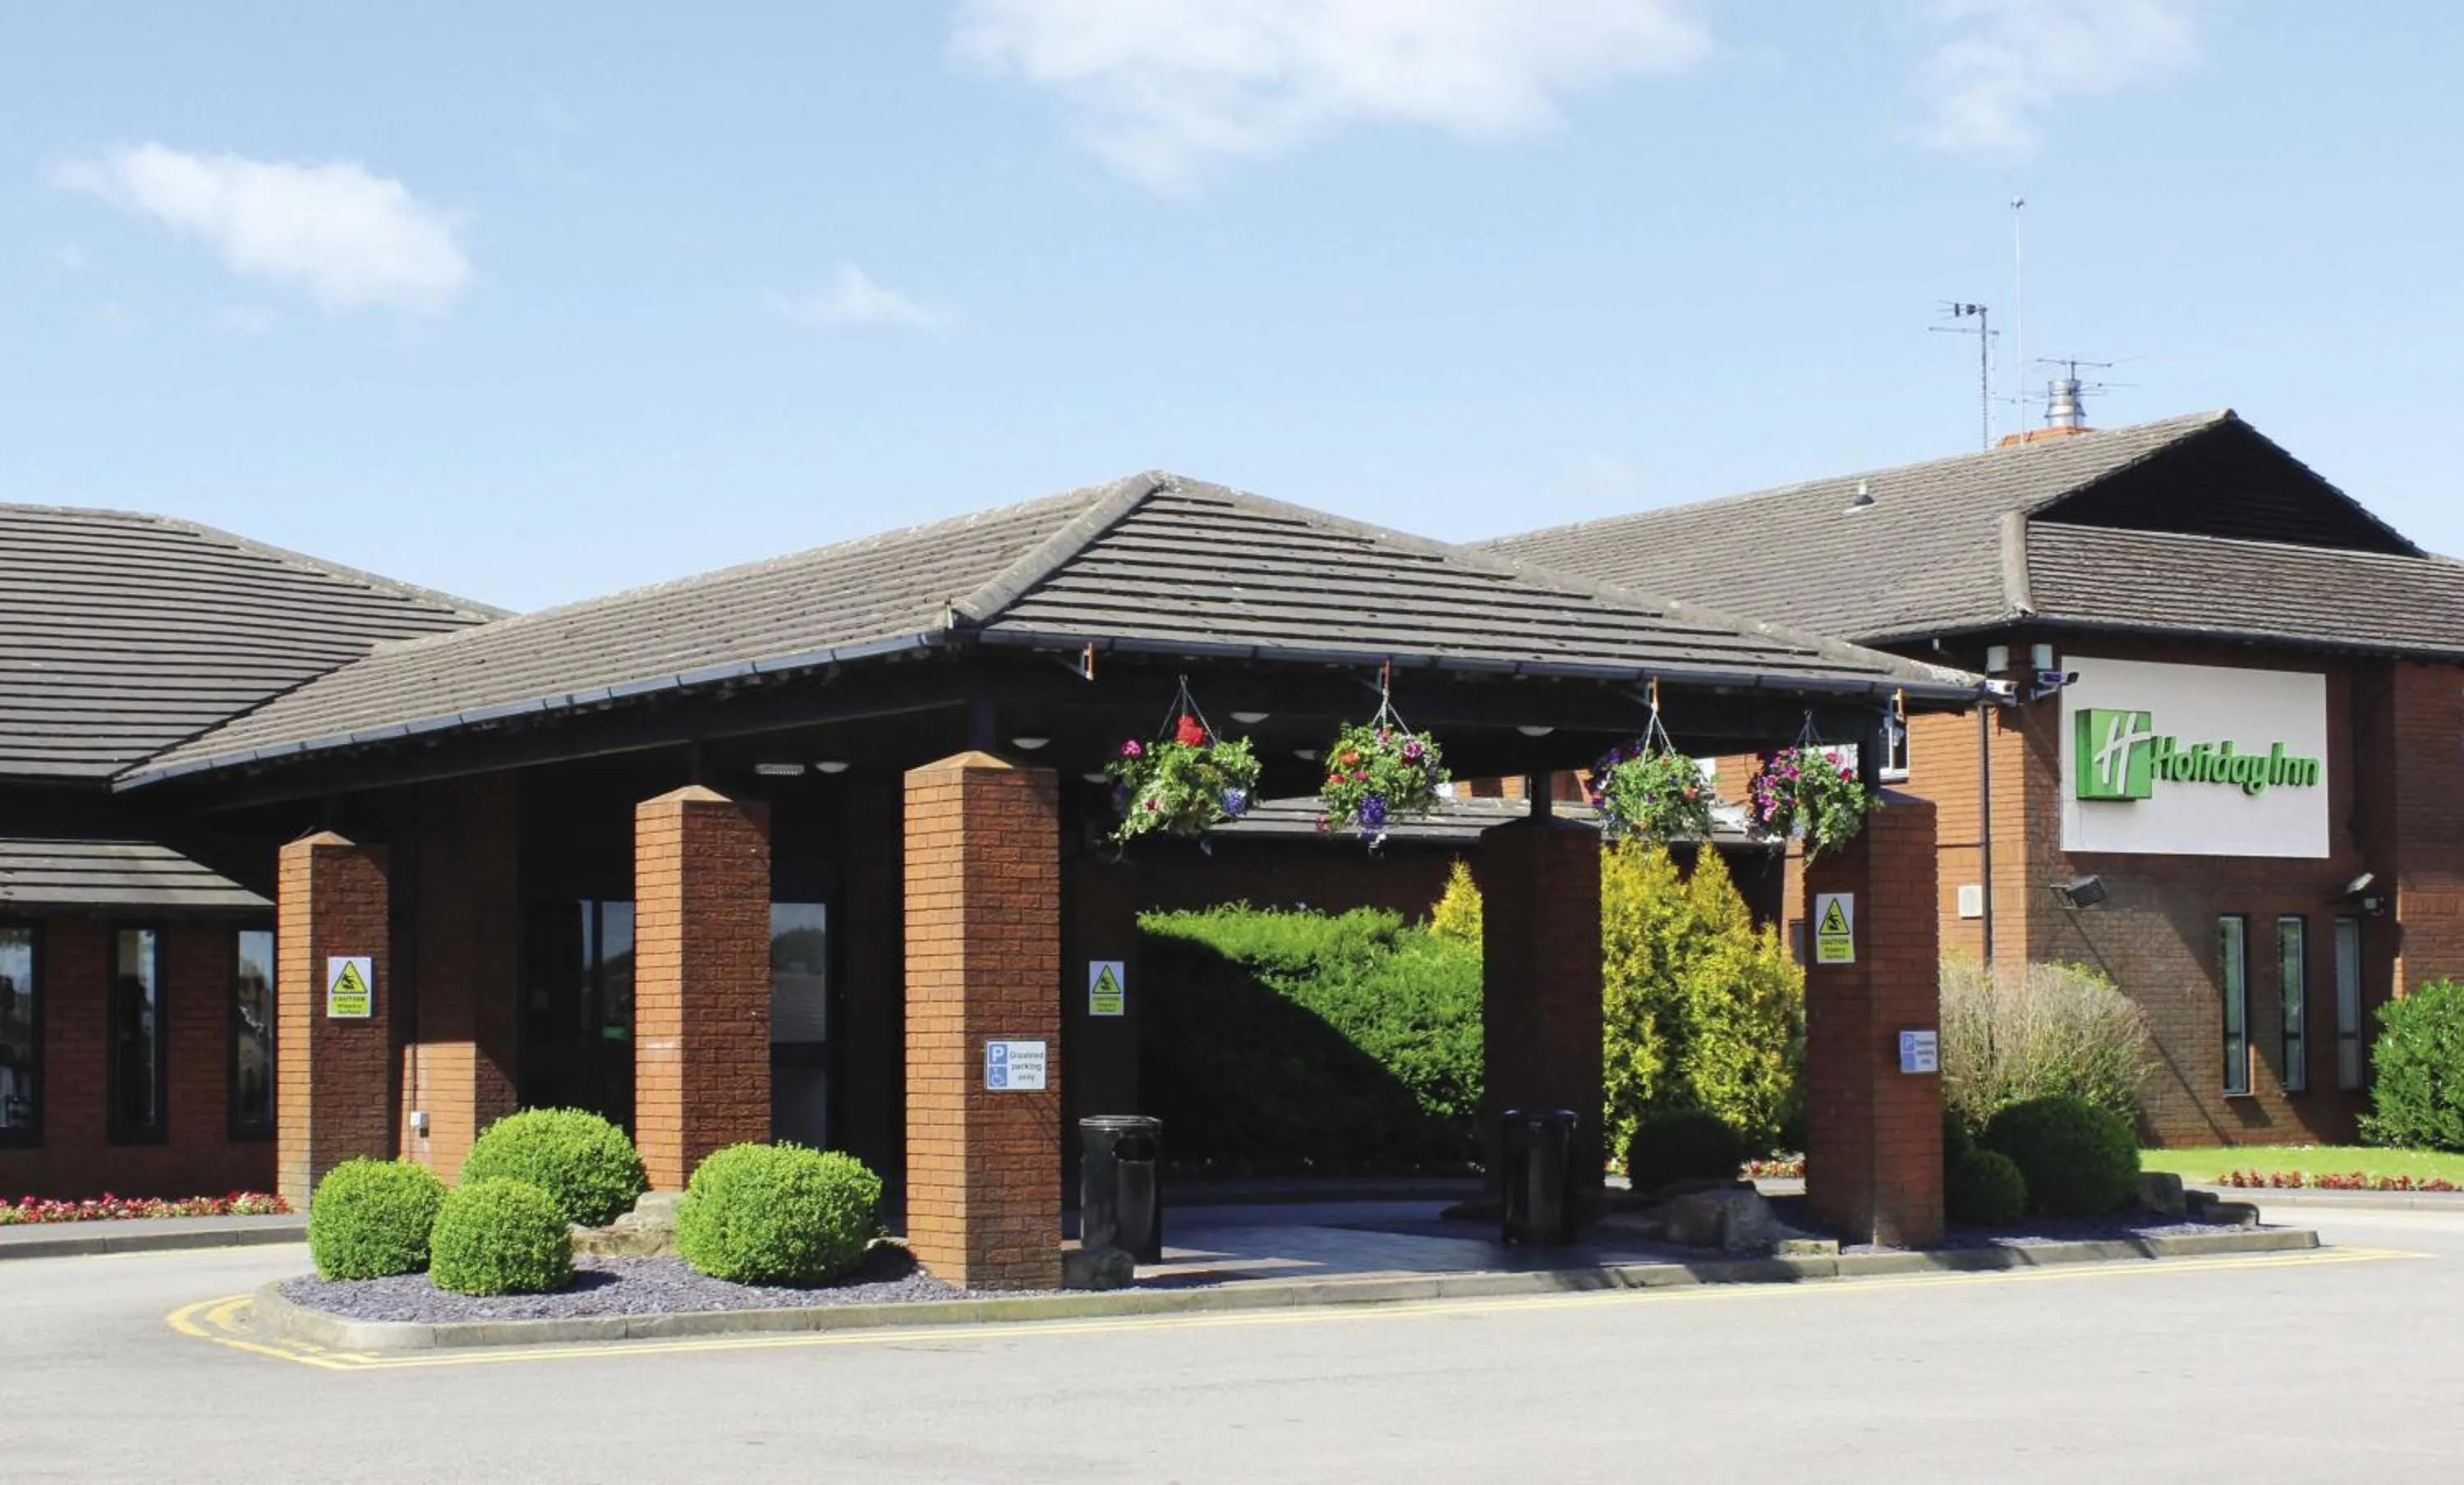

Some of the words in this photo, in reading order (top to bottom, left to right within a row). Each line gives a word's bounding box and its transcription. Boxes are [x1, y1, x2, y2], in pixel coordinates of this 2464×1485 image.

[2149, 735, 2269, 796] Holiday
[2269, 742, 2320, 786] Inn
[991, 1046, 1004, 1062] P
[1012, 1062, 1041, 1072] parking
